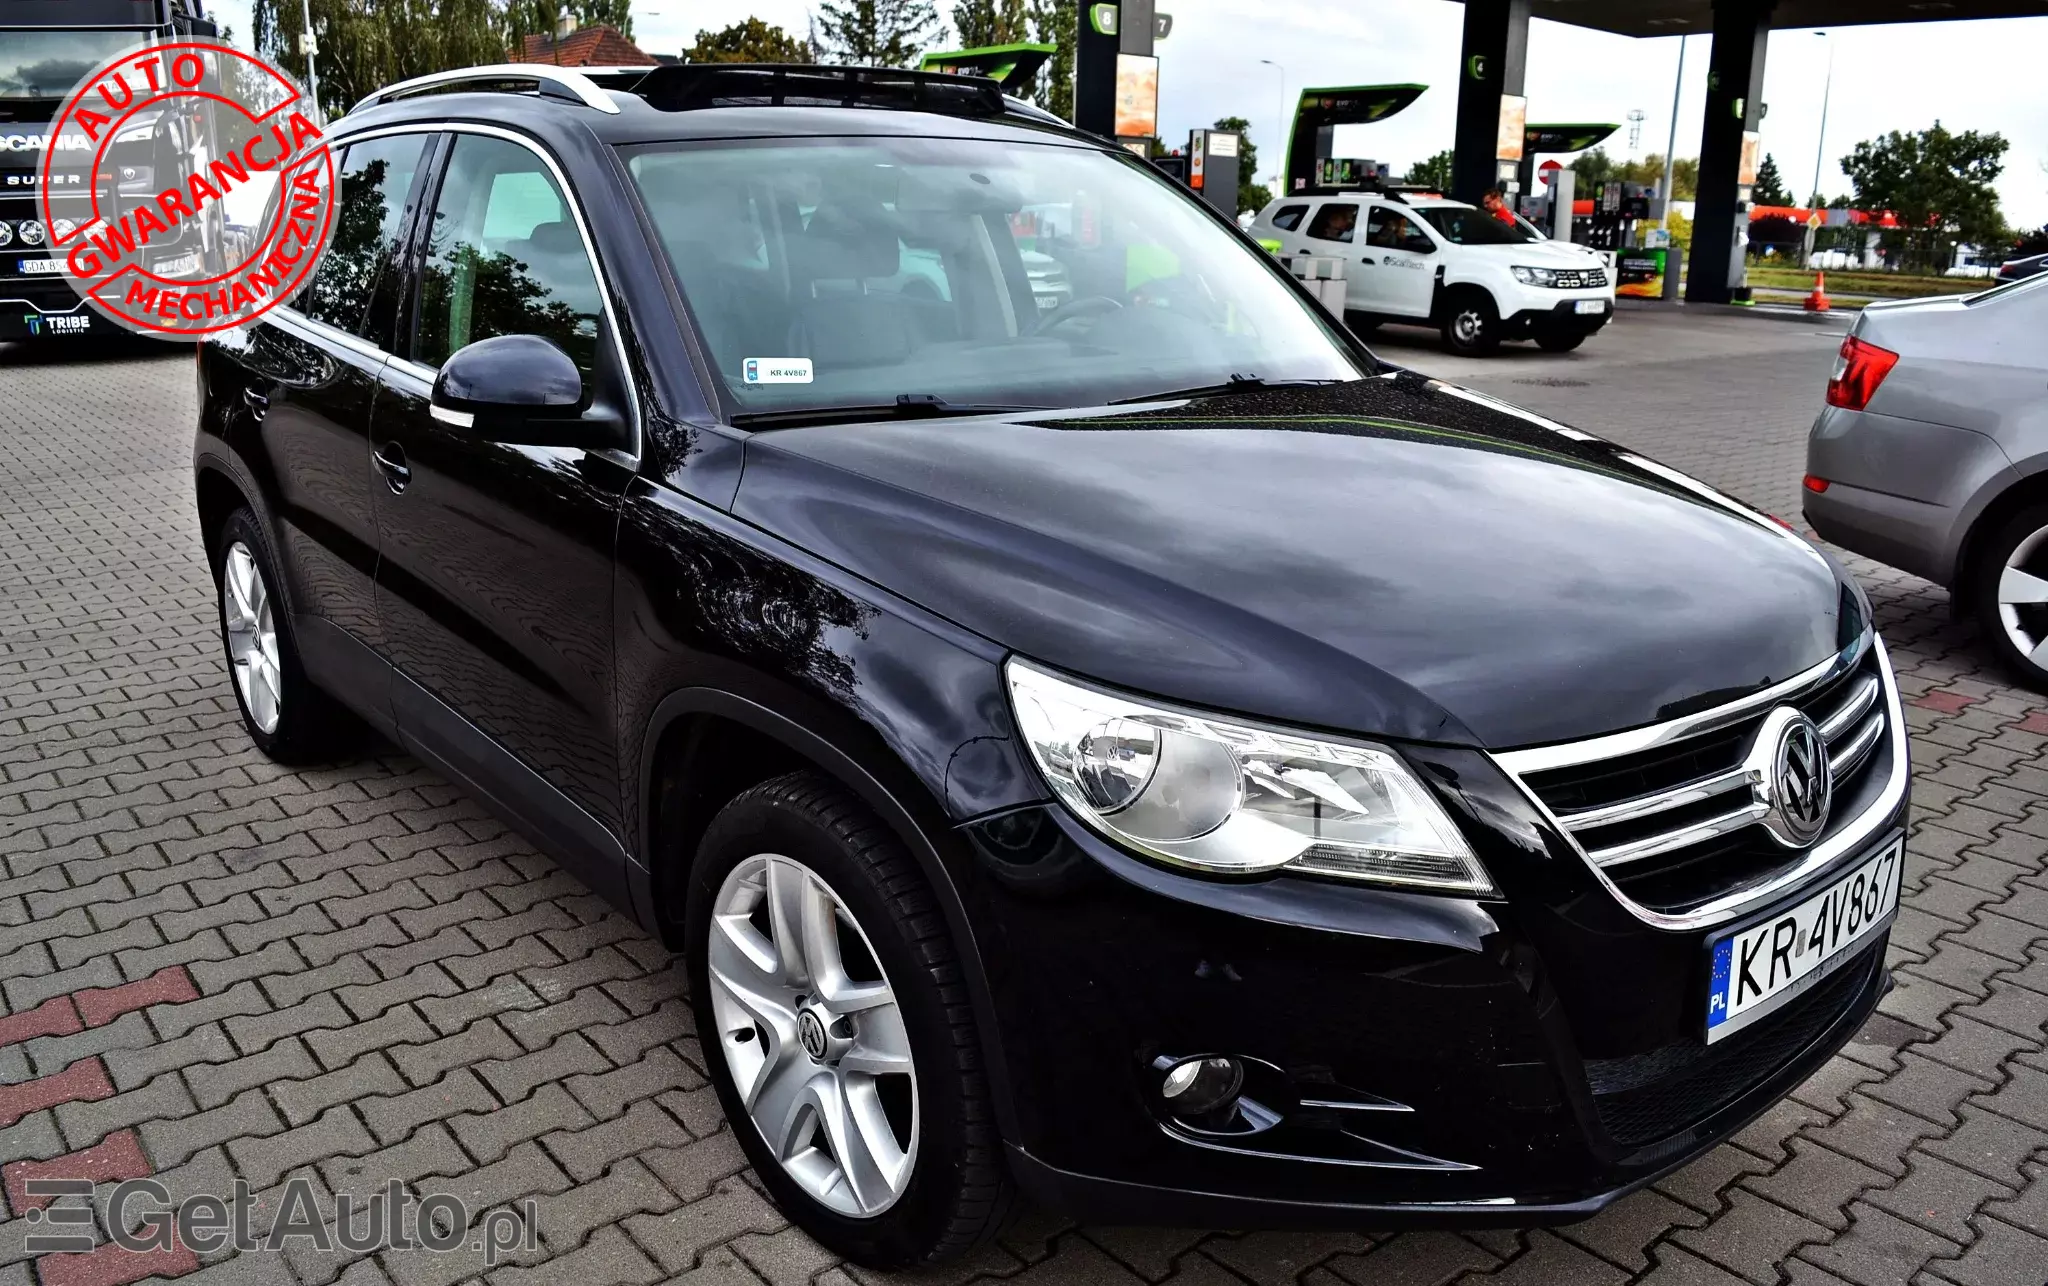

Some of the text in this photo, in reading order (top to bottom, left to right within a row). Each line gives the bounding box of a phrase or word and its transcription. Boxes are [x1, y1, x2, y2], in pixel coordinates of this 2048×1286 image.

[1103, 11, 1112, 26] 8
[1158, 18, 1167, 32] 7
[7, 174, 81, 185] SUPER
[46, 316, 91, 329] TRIBE
[770, 369, 807, 377] KR 4V867
[1736, 916, 1798, 1007] KR
[1807, 846, 1897, 960] 4V867
[1709, 991, 1726, 1015] PL
